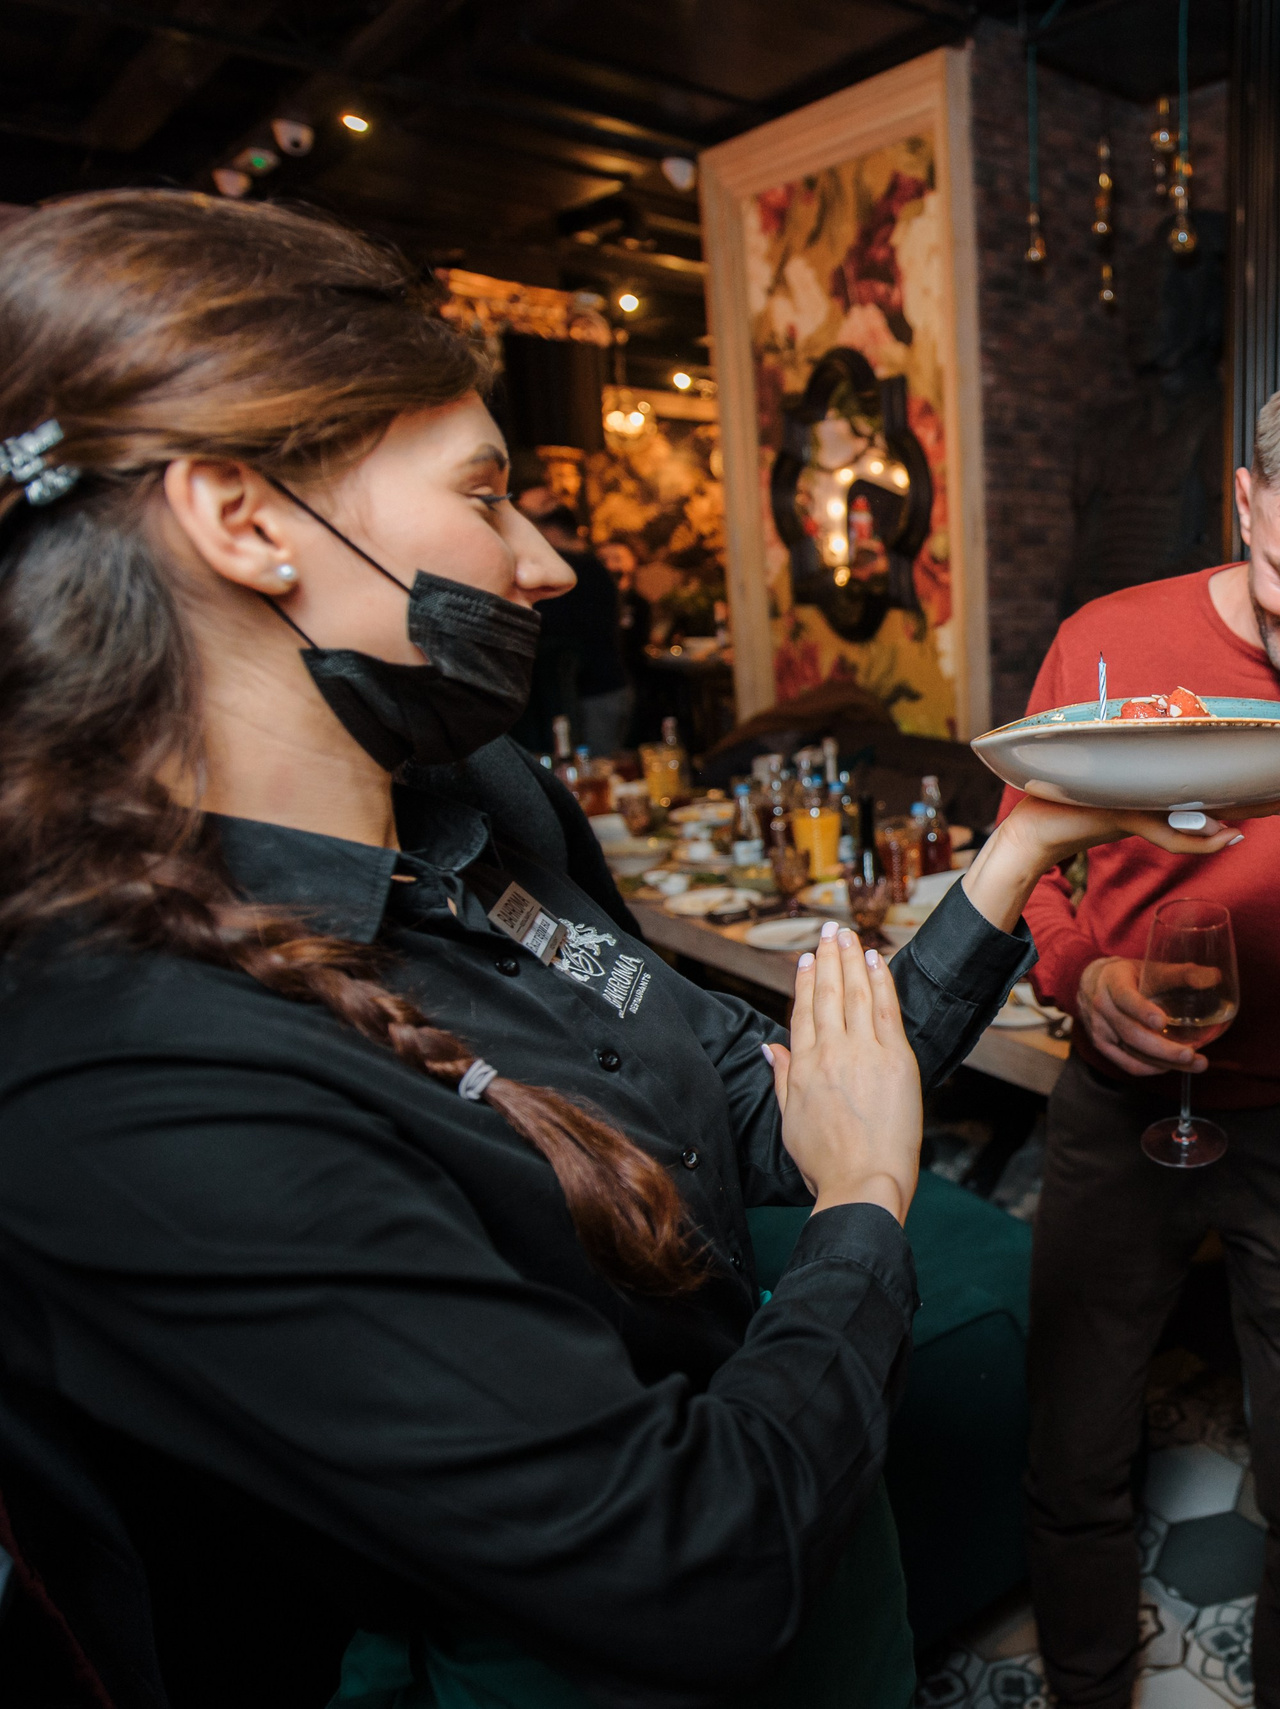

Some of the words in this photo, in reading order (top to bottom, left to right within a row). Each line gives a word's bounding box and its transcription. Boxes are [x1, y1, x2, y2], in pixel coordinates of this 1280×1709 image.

[496, 891, 530, 929] BAHROMA
[525, 918, 551, 954] Екатерина
[602, 954, 644, 1009] BAHROMA
[629, 972, 651, 1014] RESTAURANTS
